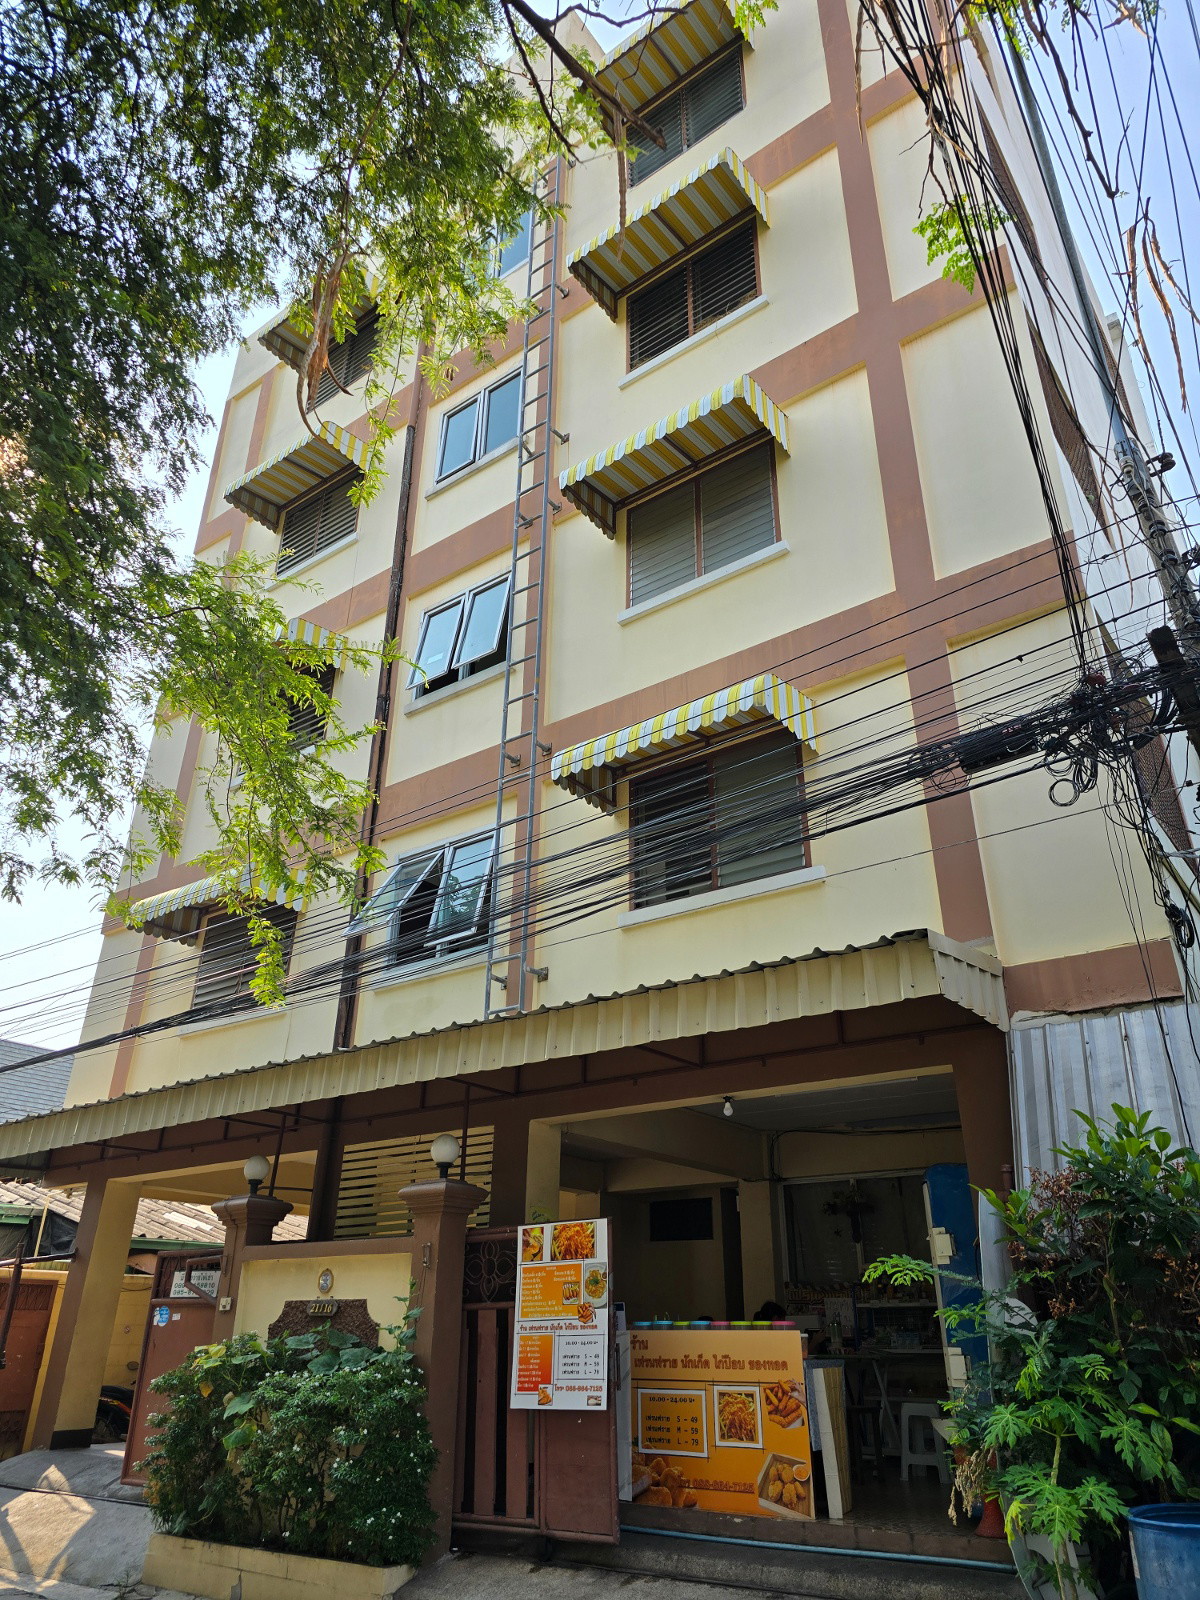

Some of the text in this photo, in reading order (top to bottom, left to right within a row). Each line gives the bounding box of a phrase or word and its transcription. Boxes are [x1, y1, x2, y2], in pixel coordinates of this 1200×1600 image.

[310, 1303, 332, 1313] 21/16
[630, 1334, 648, 1350] ร้าน
[748, 1359, 788, 1371] ของทอด
[691, 1427, 699, 1435] 59
[691, 1438, 699, 1446] 79
